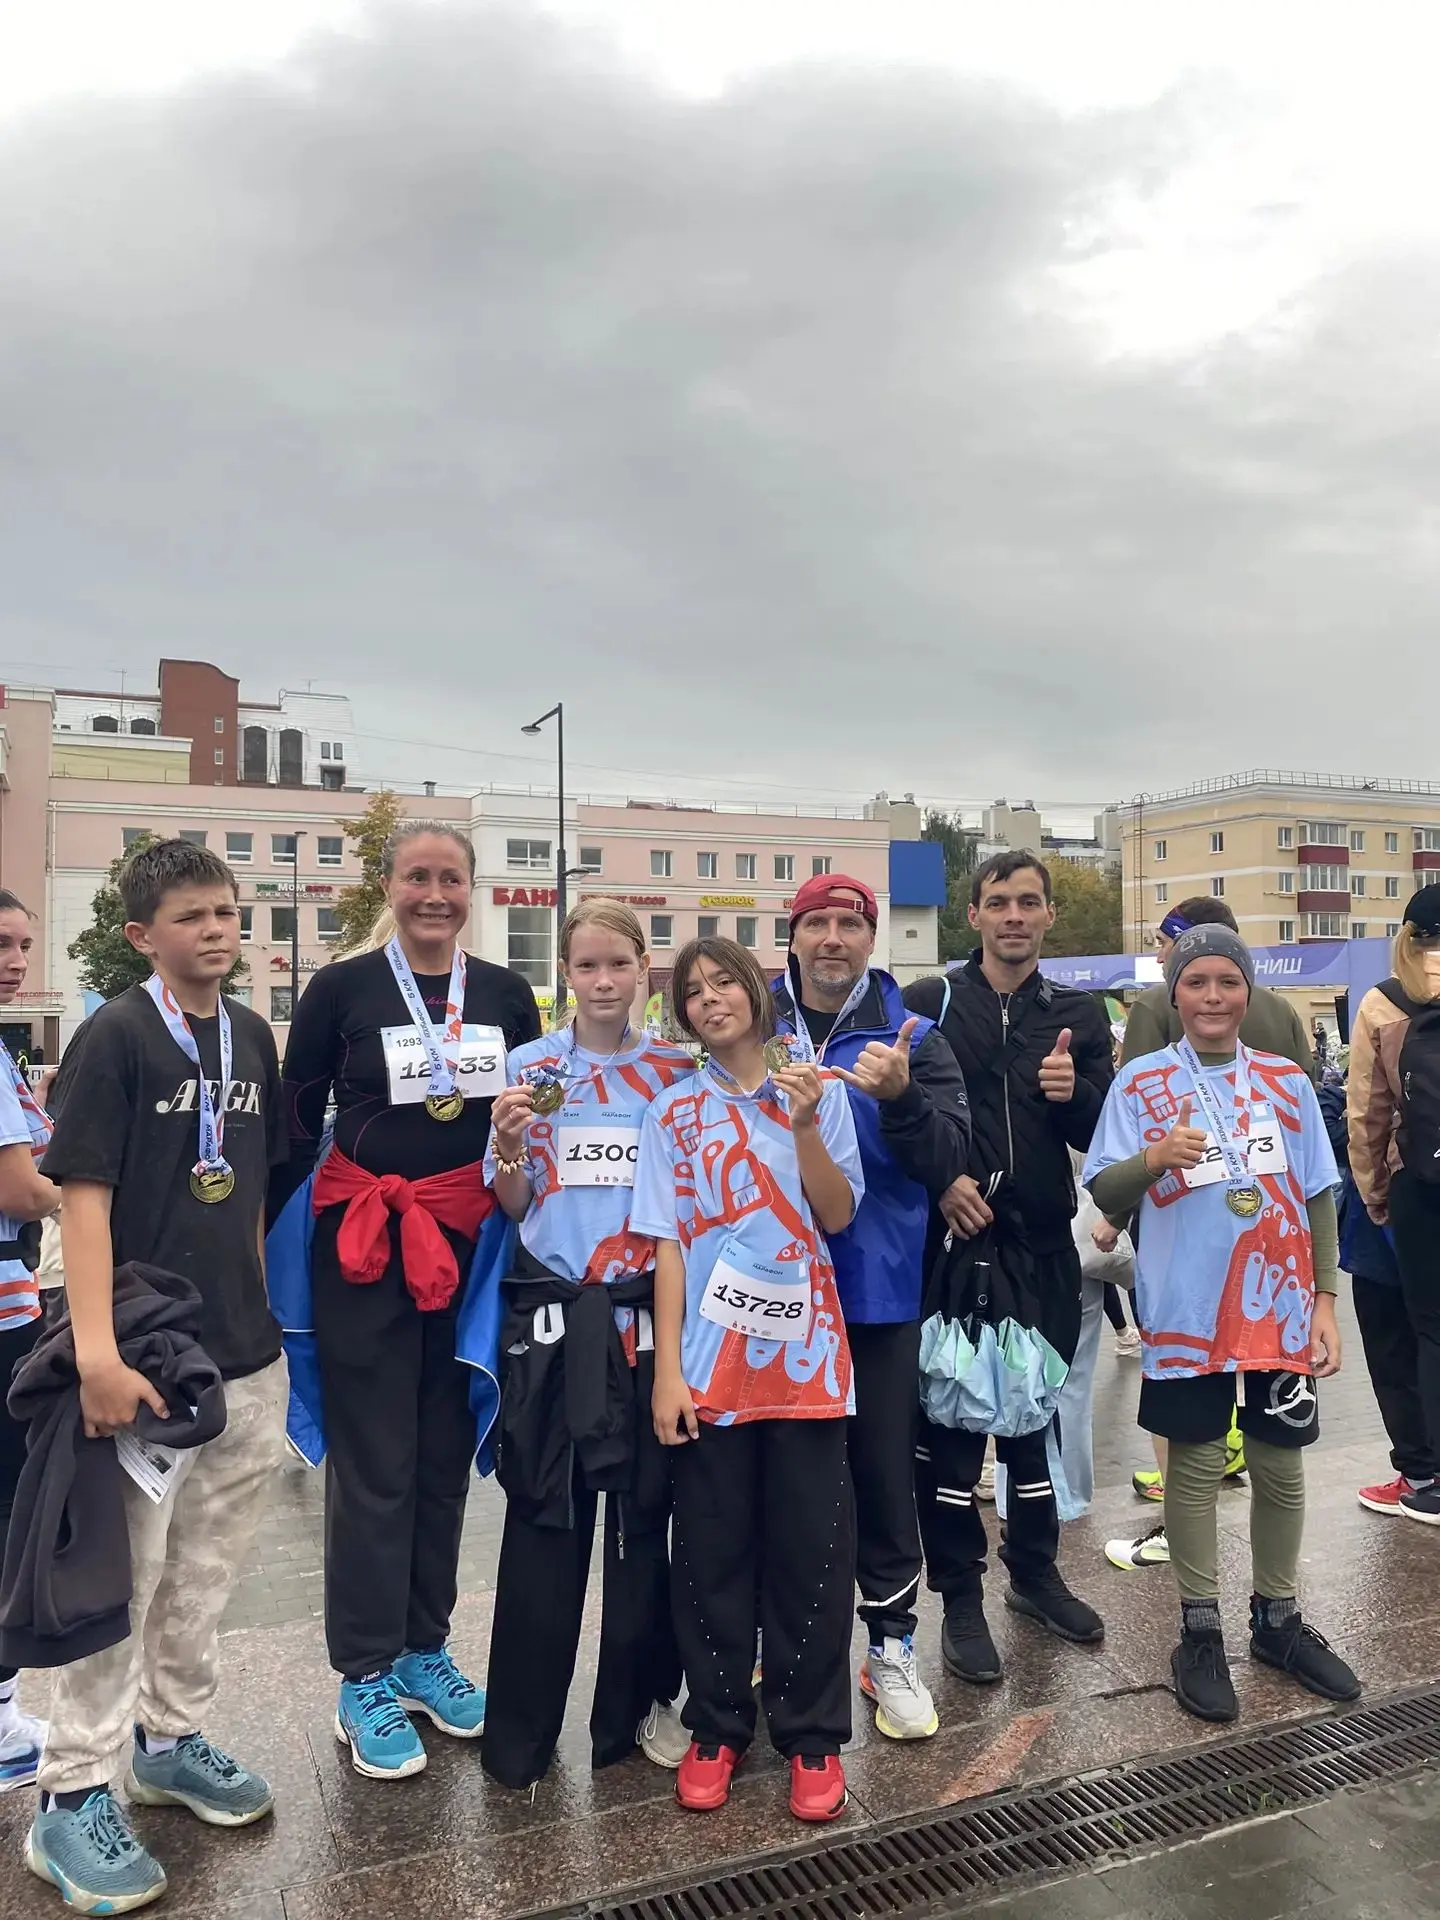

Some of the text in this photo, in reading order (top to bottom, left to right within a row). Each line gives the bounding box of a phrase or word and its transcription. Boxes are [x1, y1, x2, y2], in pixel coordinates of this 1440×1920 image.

[400, 1055, 497, 1080] 1233
[204, 1123, 213, 1161] МАРАФО
[712, 1284, 804, 1319] 13728
